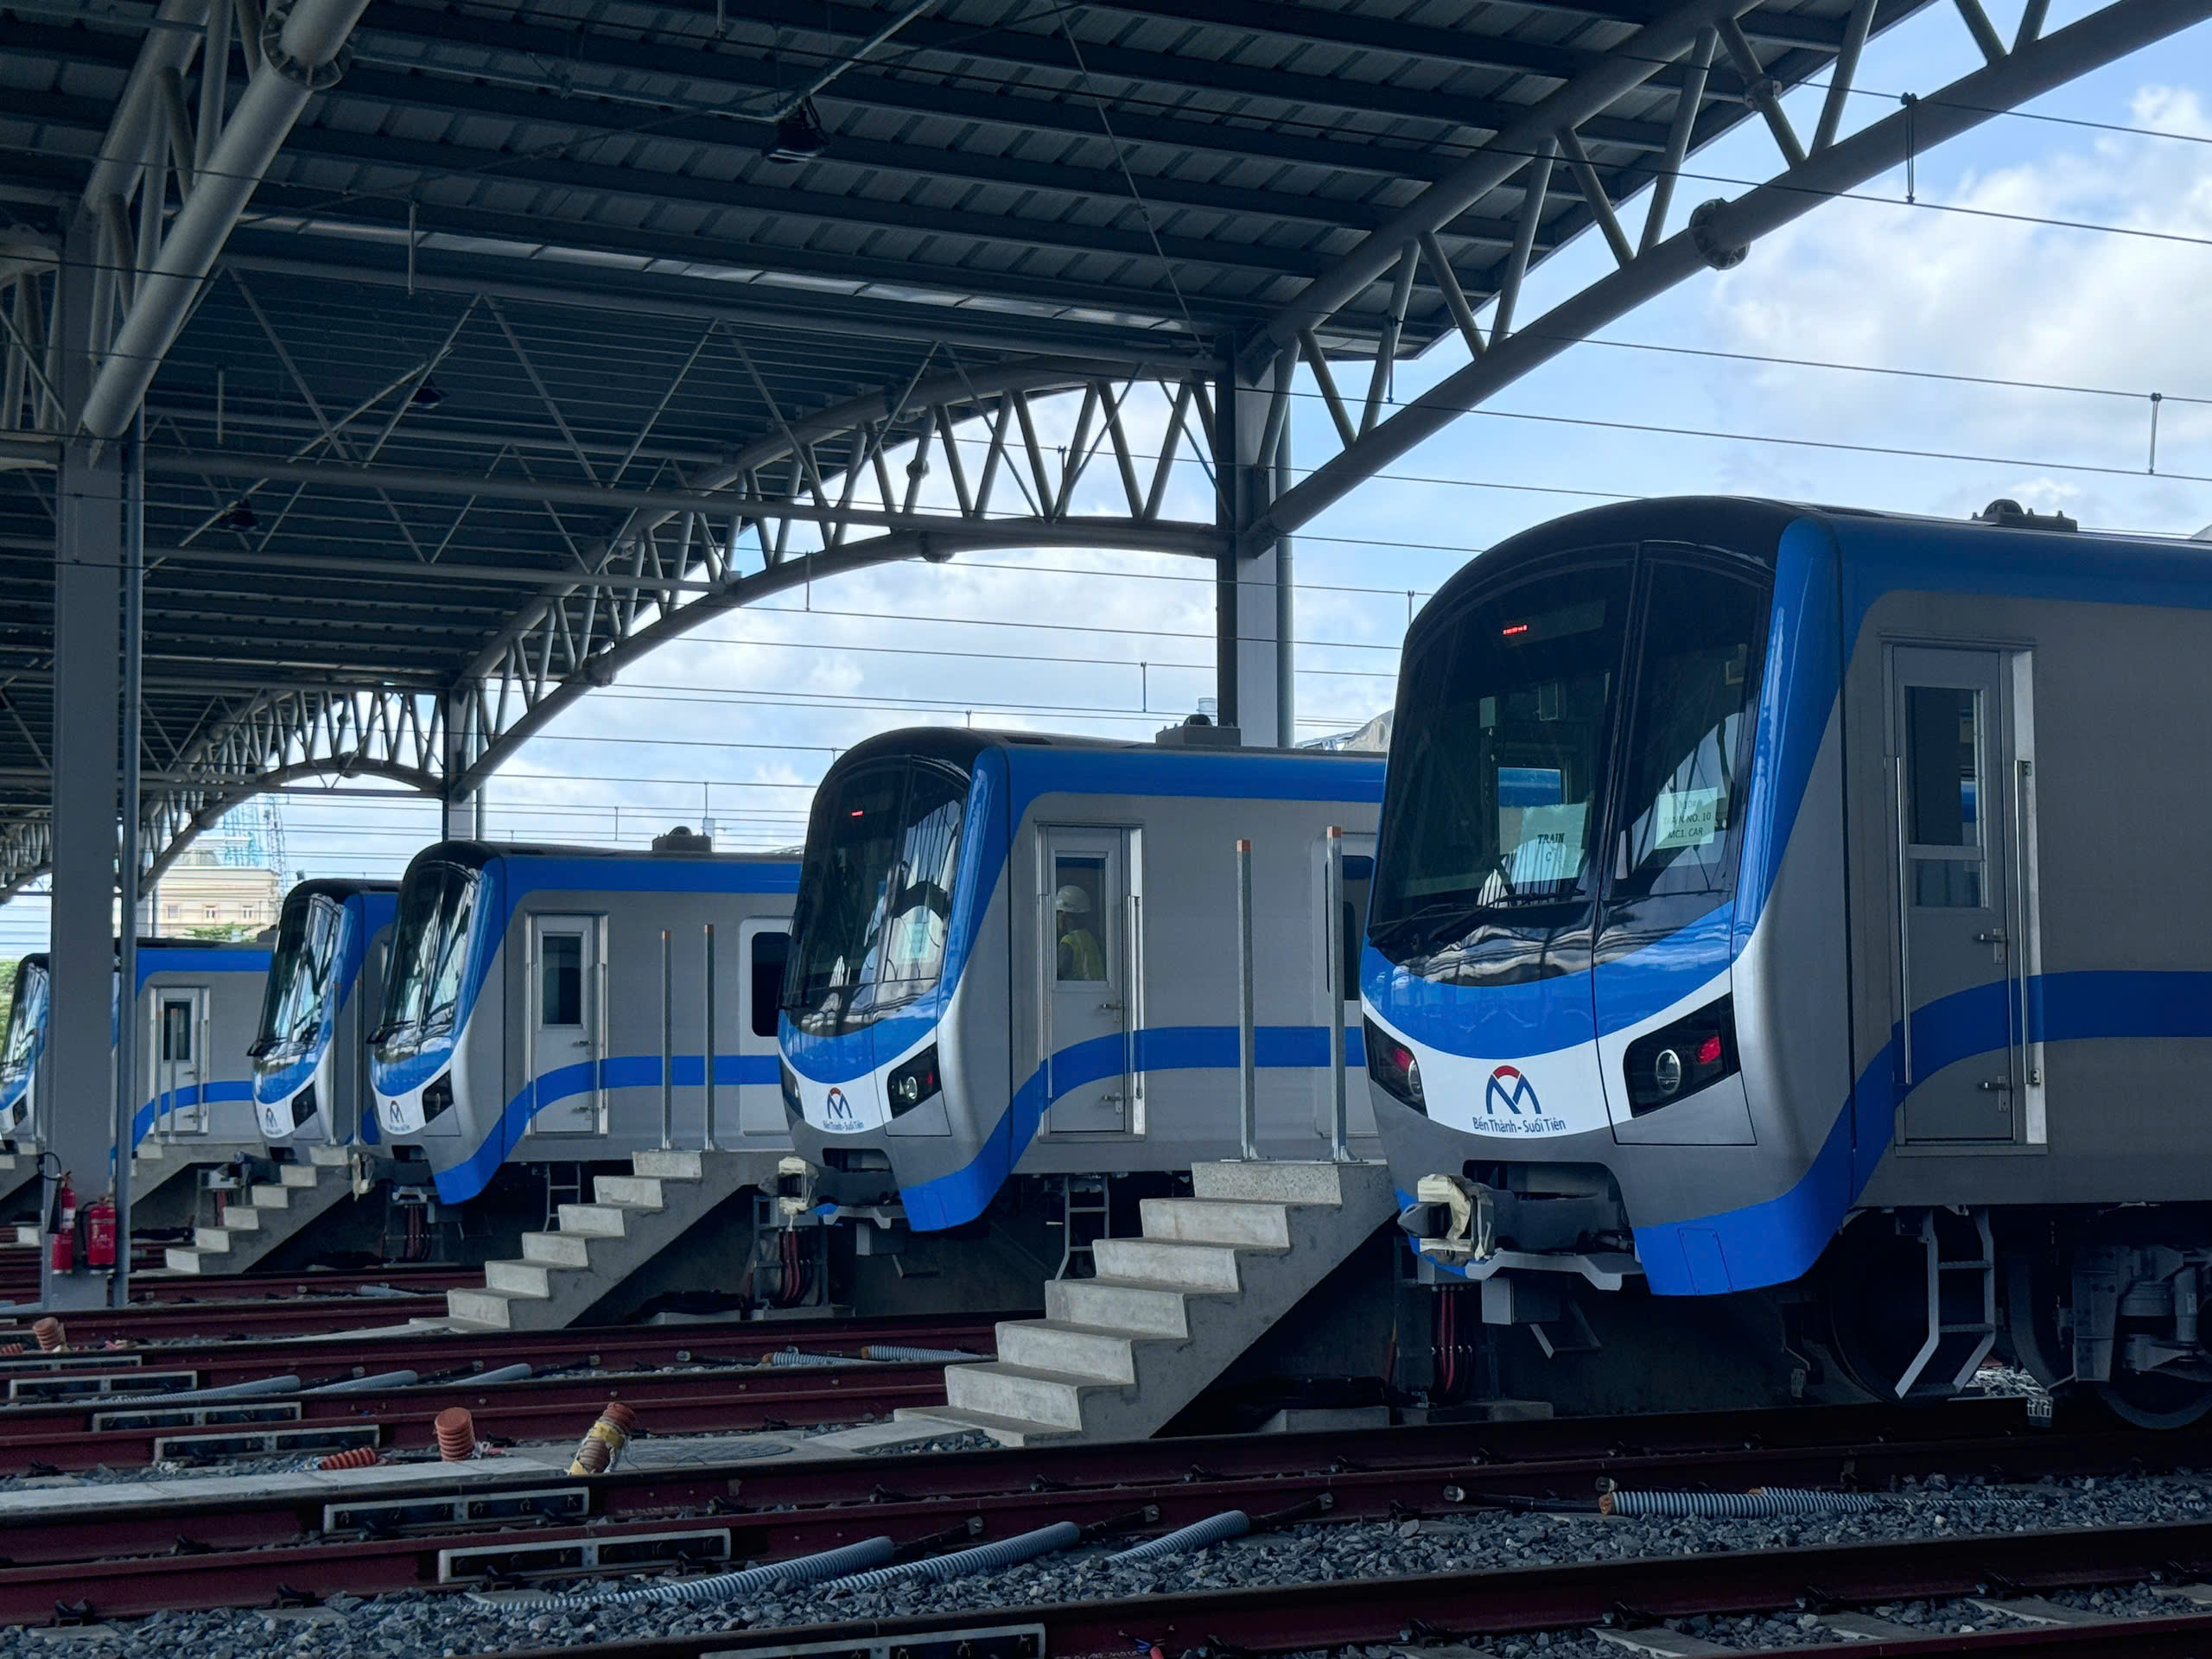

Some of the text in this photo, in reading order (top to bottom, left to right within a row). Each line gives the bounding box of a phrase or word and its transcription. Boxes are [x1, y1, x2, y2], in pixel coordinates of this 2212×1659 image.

[1702, 812, 1712, 821] 10
[1688, 827, 1703, 836] CAR
[1537, 833, 1565, 843] TRAIN
[1488, 1119, 1517, 1133] Thành
